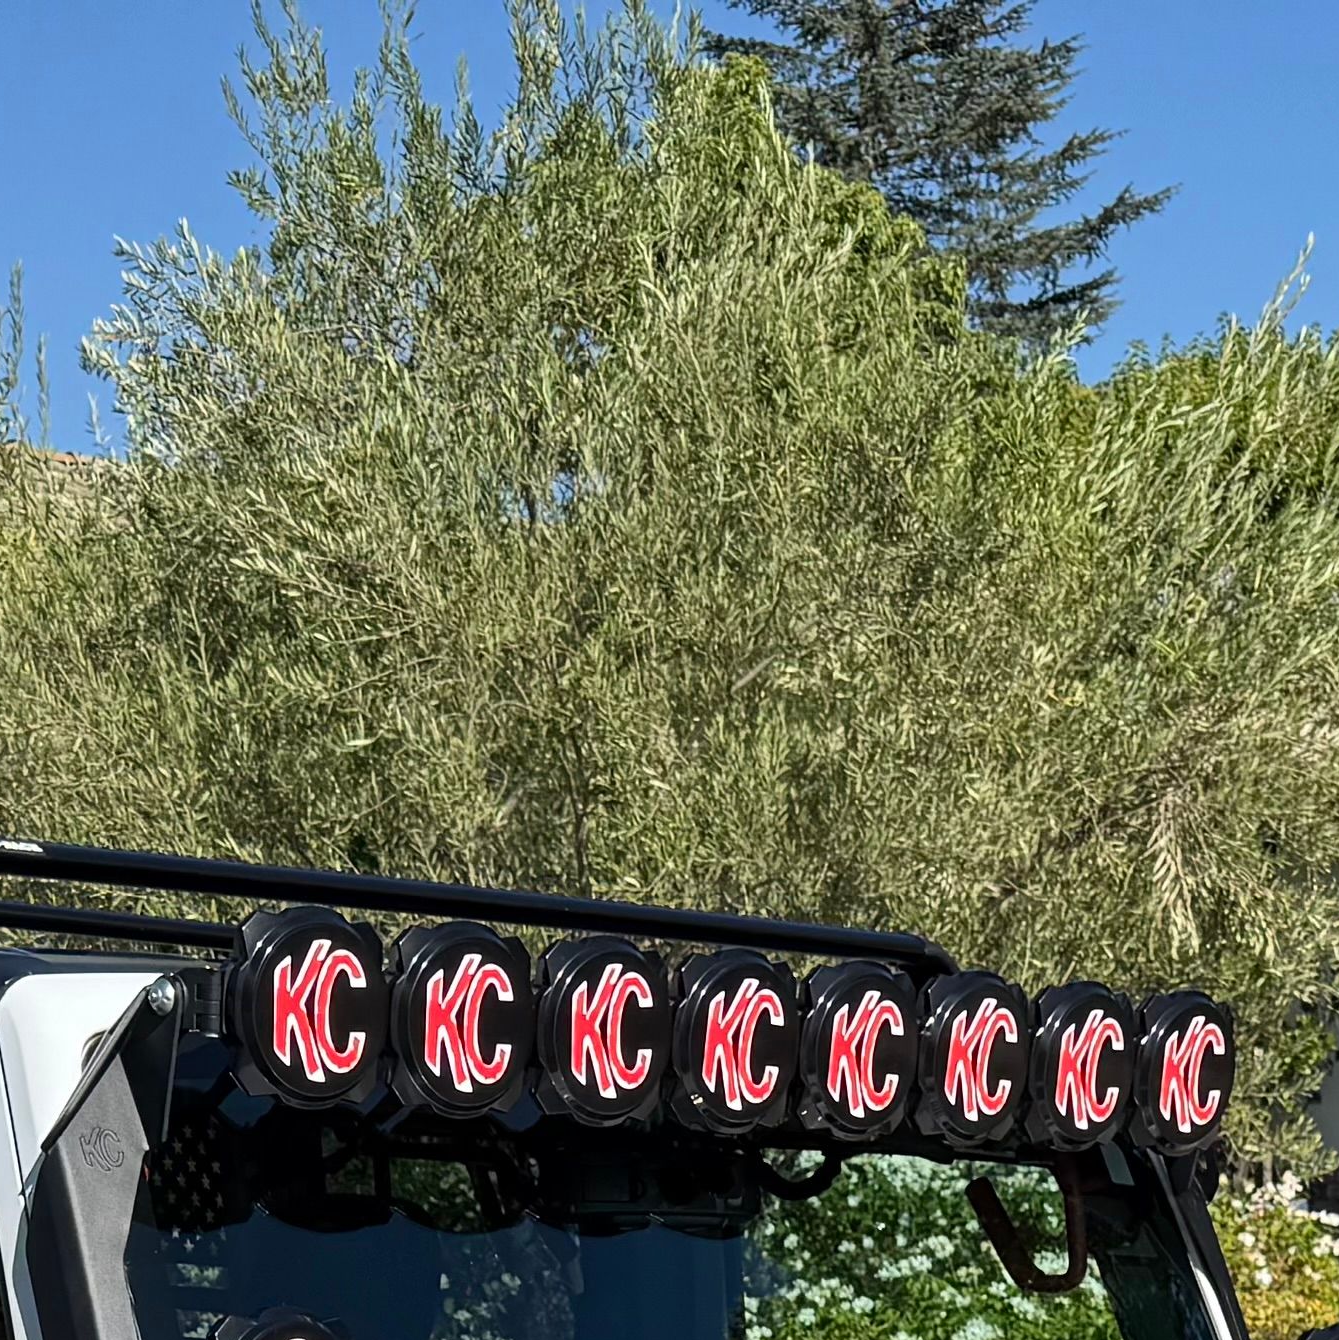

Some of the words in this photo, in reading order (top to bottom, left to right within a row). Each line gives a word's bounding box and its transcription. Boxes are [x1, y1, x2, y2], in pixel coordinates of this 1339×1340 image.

[273, 938, 367, 1083] KC
[424, 953, 514, 1093] KC
[570, 962, 654, 1099] KC
[701, 977, 786, 1113] KC
[827, 989, 905, 1118] KC
[944, 997, 1019, 1122] KC
[1055, 1008, 1125, 1131] KC
[1160, 1014, 1227, 1134] KC
[78, 1126, 126, 1172] KC
